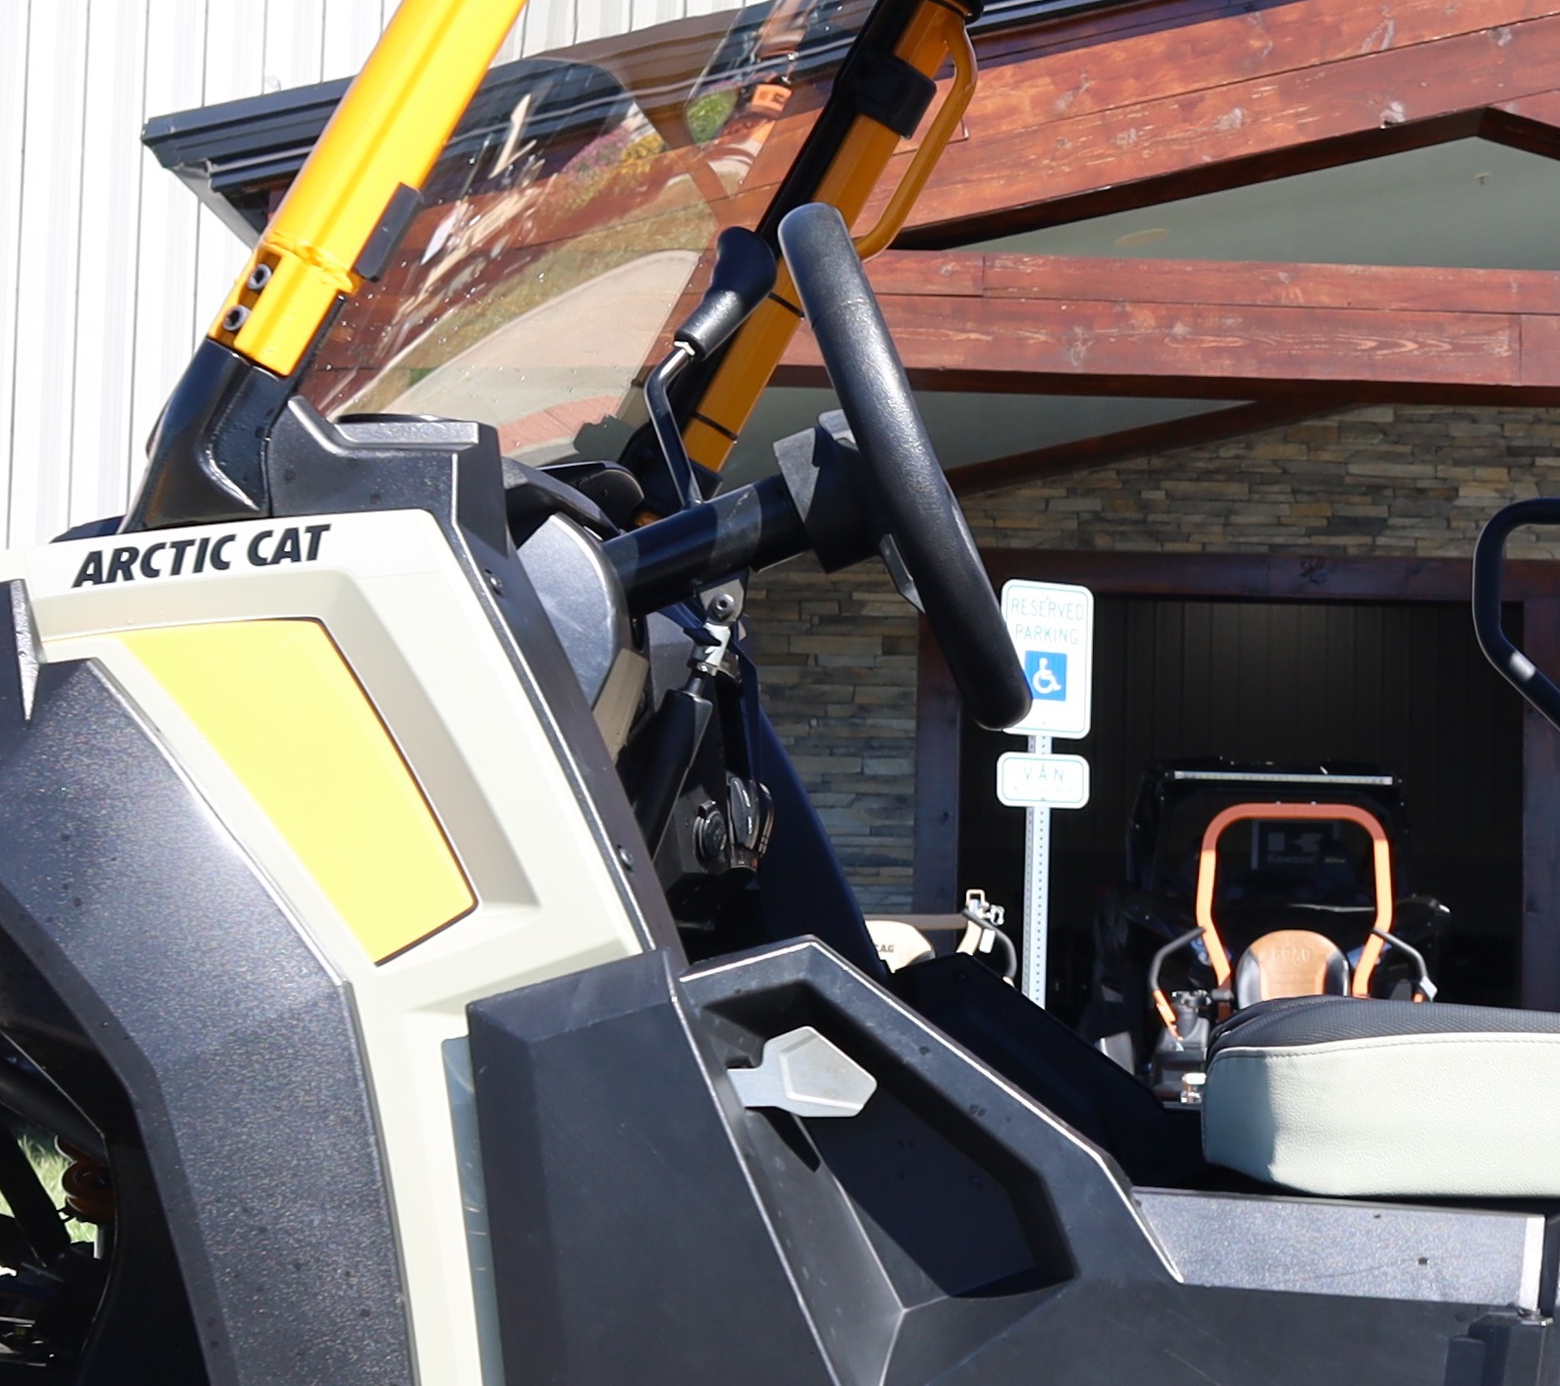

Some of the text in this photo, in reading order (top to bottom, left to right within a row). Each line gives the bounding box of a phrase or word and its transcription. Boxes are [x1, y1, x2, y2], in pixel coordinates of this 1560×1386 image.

[72, 524, 331, 588] ARCTIC CAT
[1011, 597, 1084, 621] RESERVED
[1015, 624, 1078, 645] PARKING
[1024, 766, 1064, 783] VAN
